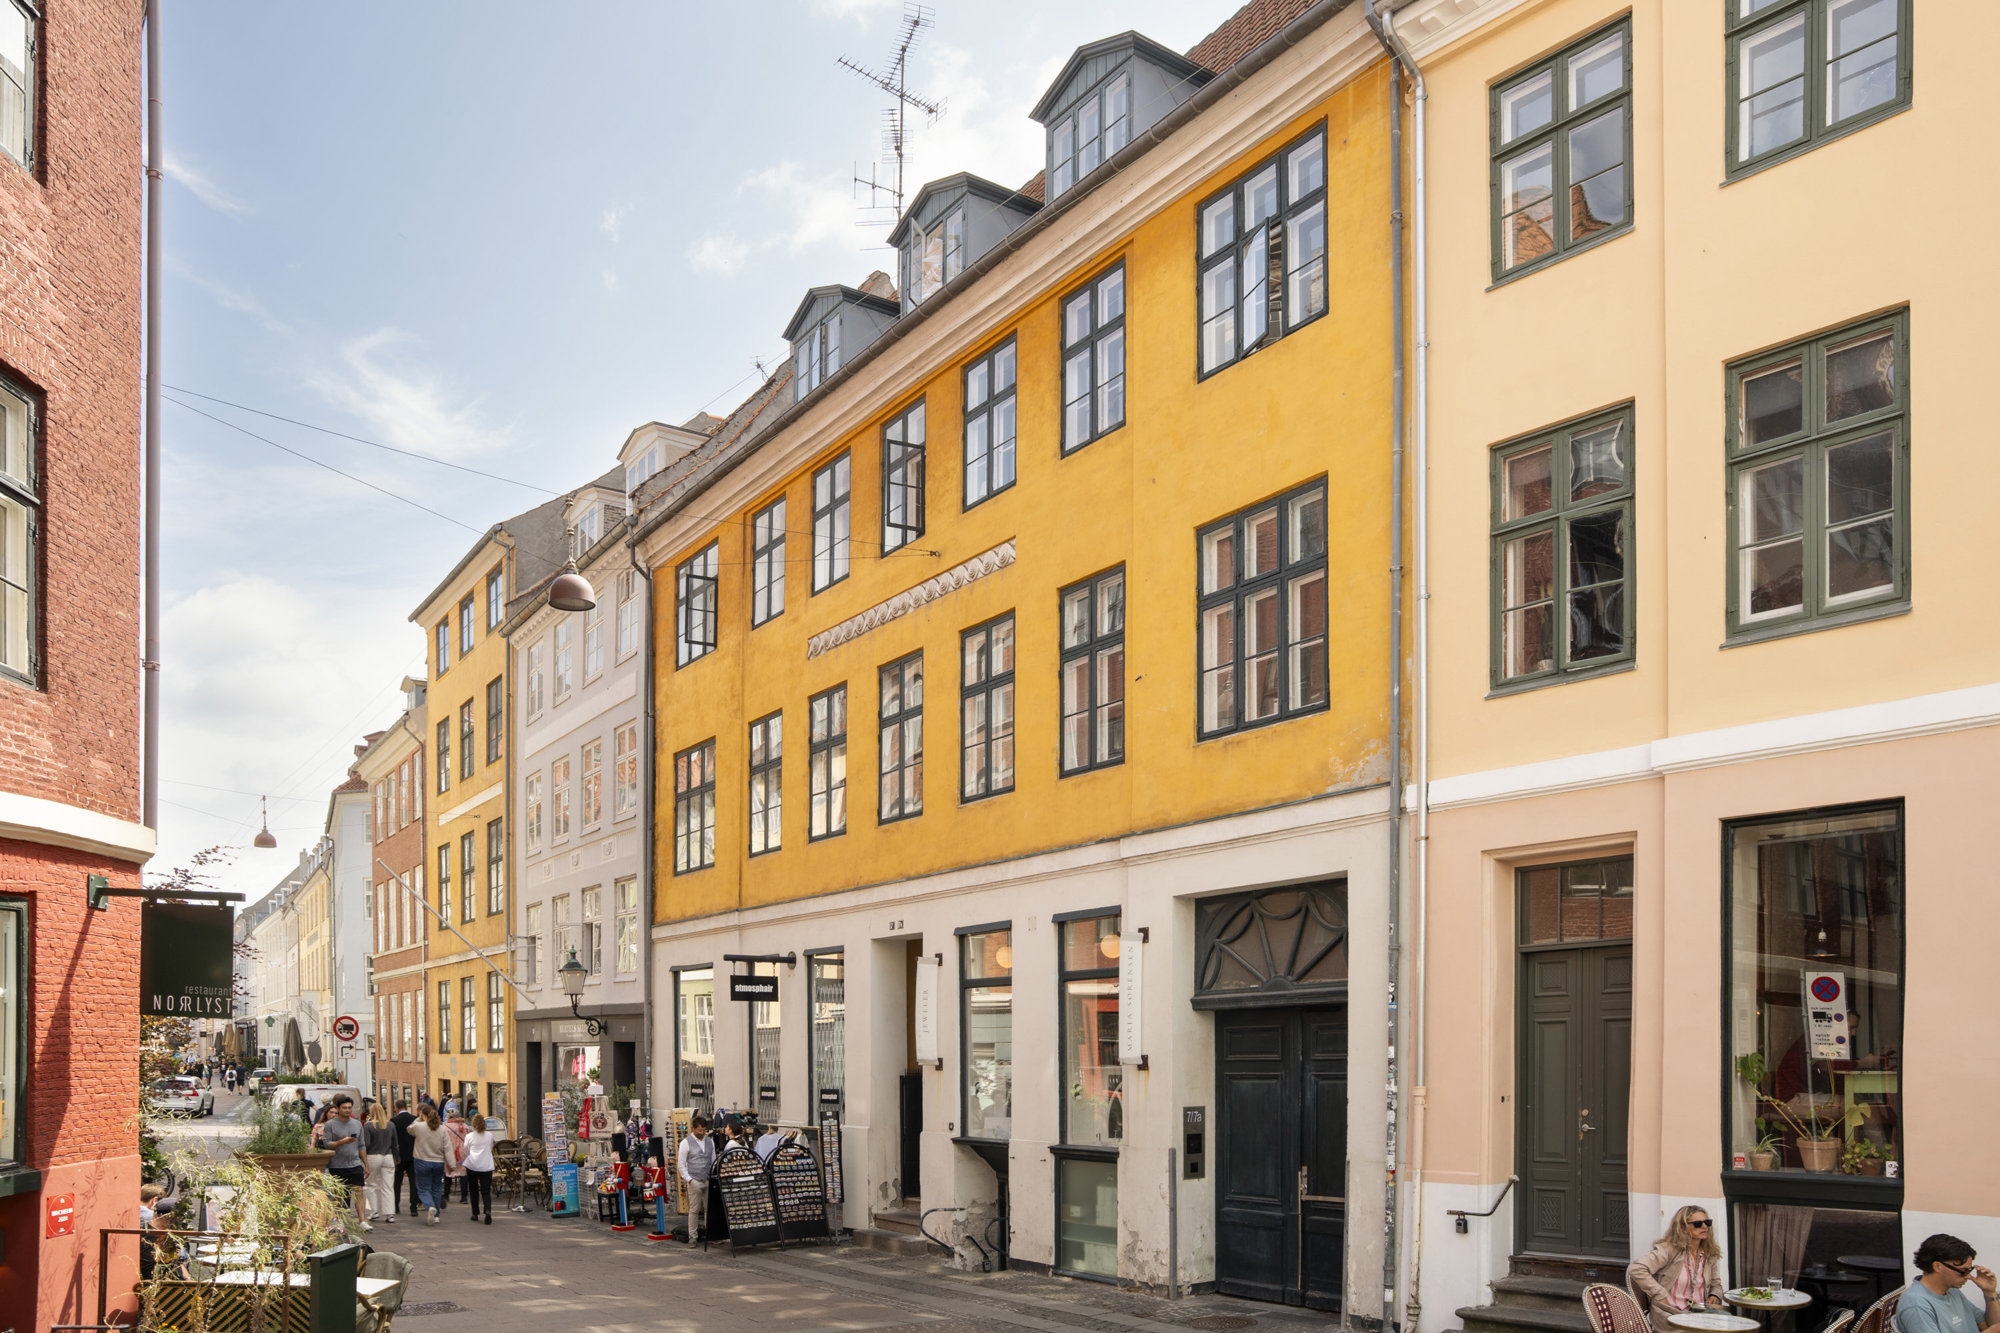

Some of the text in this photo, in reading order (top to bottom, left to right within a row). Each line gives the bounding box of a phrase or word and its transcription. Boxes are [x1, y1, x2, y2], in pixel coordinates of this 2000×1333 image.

[184, 985, 232, 996] restaurant
[734, 984, 774, 993] atmosphair
[1186, 1111, 1202, 1123] 7/7a
